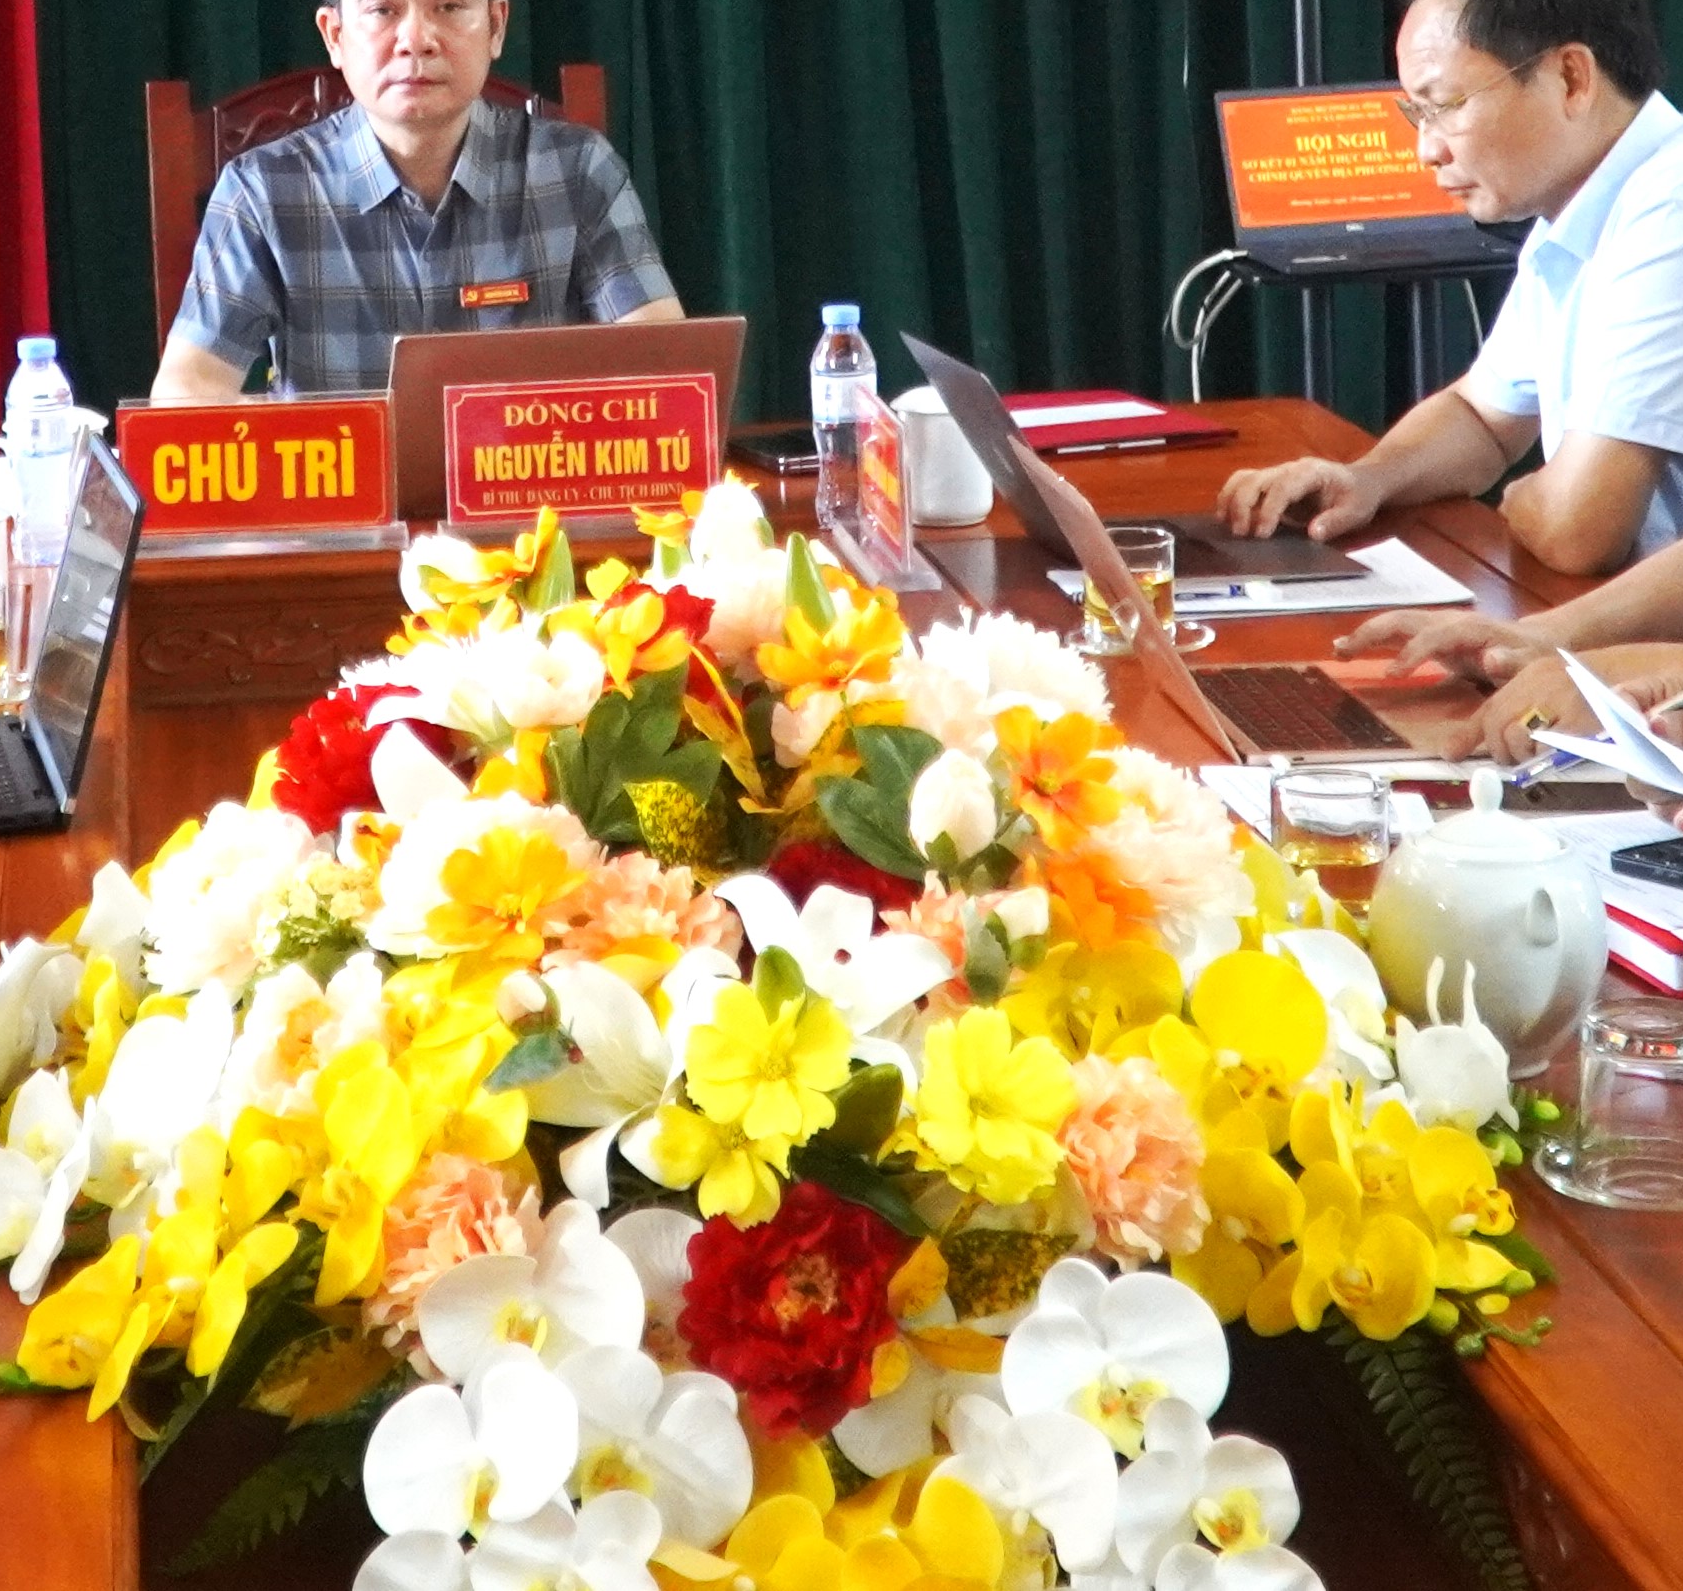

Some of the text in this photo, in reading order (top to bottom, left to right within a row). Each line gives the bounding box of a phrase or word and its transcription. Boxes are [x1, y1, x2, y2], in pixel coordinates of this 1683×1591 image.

[602, 391, 659, 422] CHÍ
[153, 421, 355, 504] CHỦ TRÌ
[474, 428, 691, 482] NGUYỄN KIM TÚ
